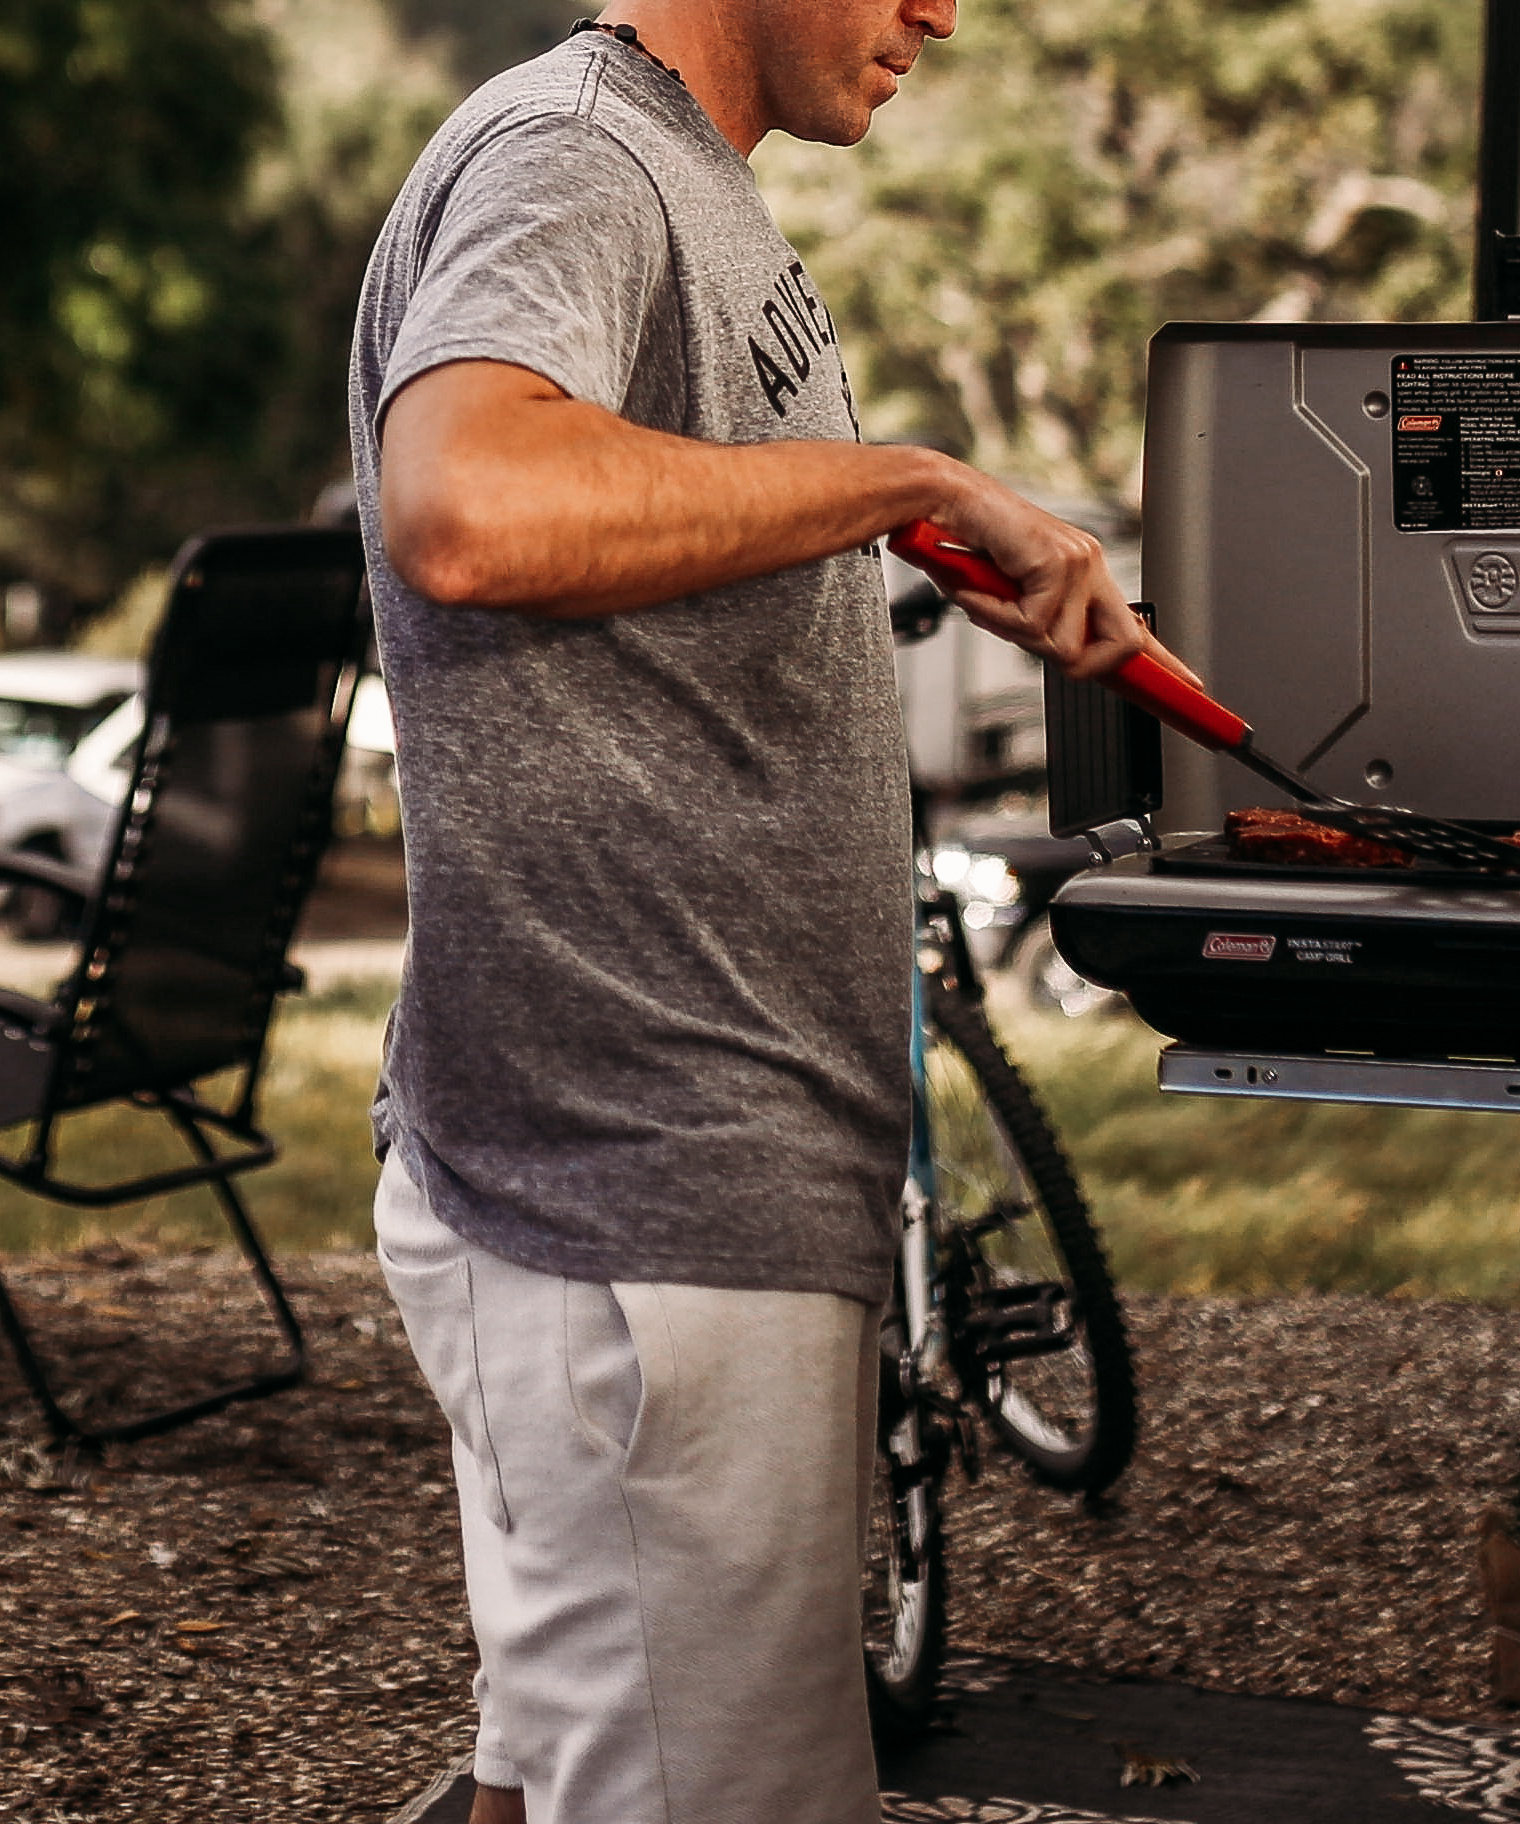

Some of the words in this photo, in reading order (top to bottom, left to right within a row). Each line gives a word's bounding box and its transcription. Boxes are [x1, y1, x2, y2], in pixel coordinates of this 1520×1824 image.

[1396, 372, 1416, 380] READ
[1418, 372, 1430, 380] ALL
[1432, 372, 1484, 380] INSTRUCTIONS
[1485, 372, 1514, 380] BEFORE
[1209, 936, 1259, 953] Coleman
[1296, 951, 1323, 962] CAMP
[1325, 952, 1354, 964] GRILL
